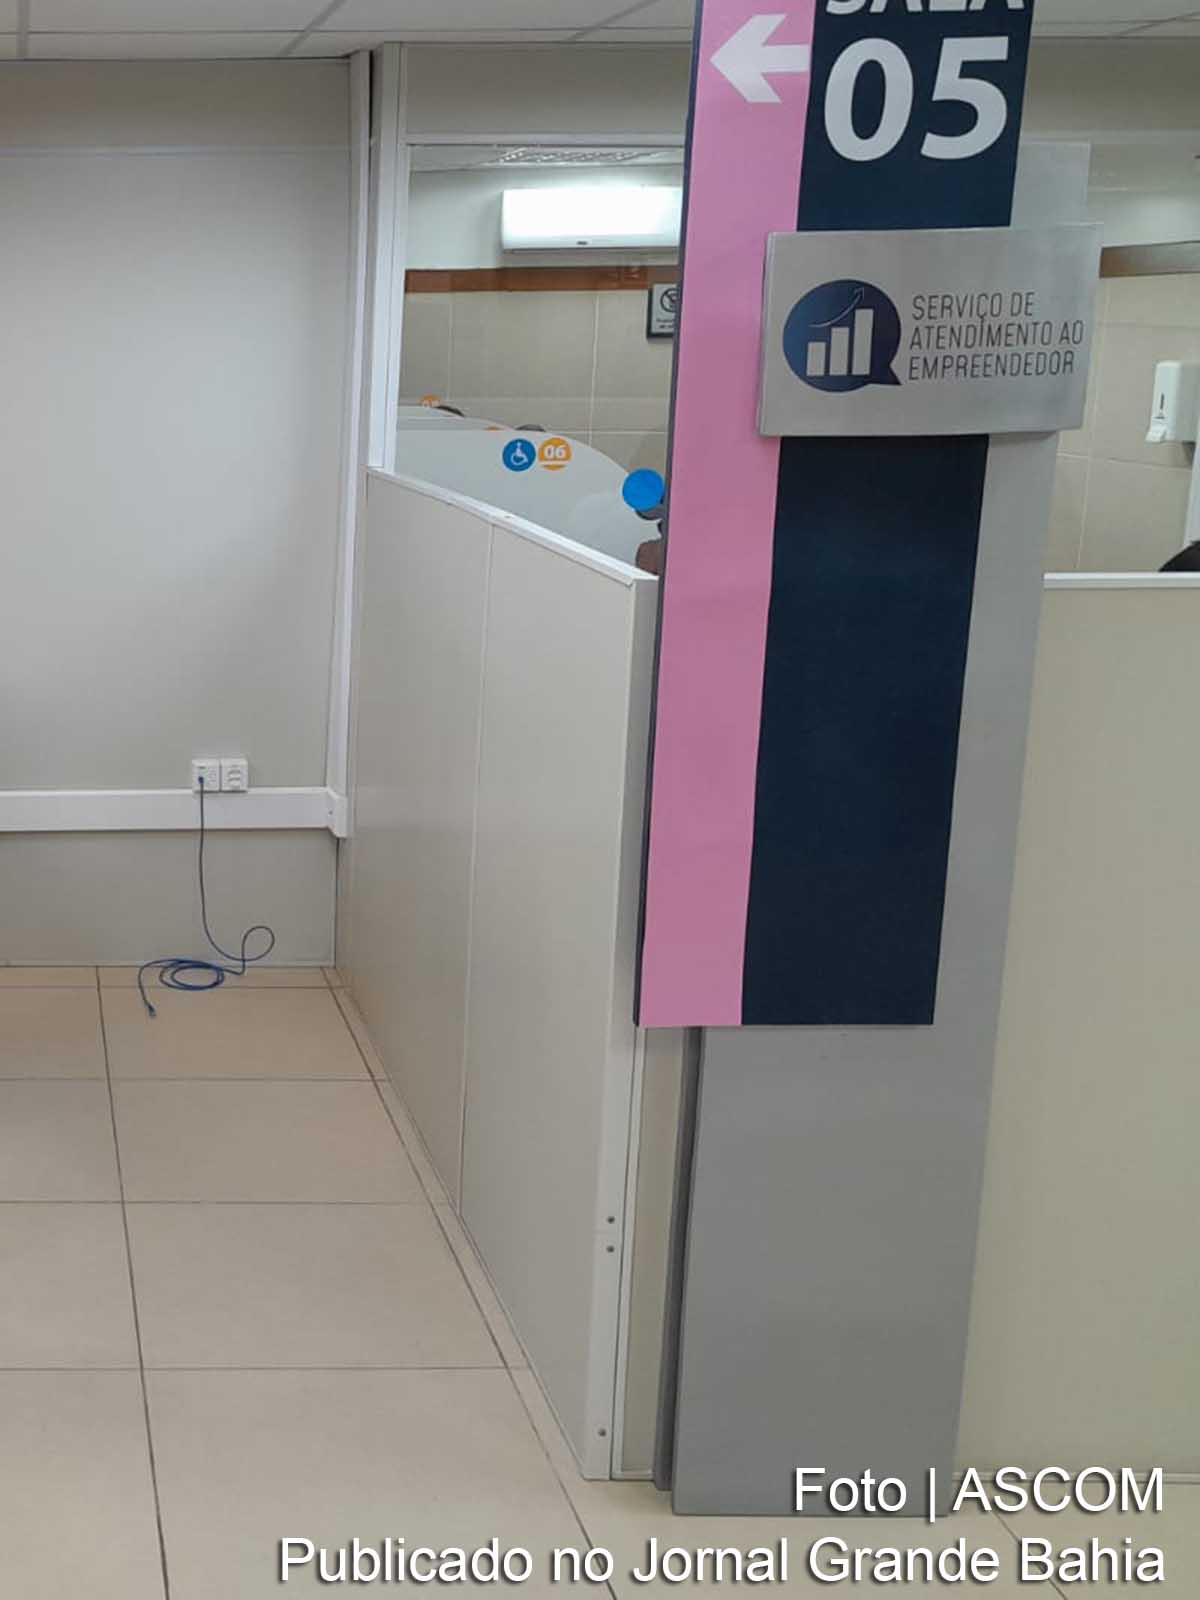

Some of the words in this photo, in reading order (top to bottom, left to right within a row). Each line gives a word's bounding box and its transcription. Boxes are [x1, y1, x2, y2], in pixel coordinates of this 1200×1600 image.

[824, 36, 1009, 161] 05
[912, 293, 1002, 320] SERVIÇO
[1010, 292, 1035, 317] DE
[910, 321, 1053, 350] ATENDIMENTO
[1059, 320, 1084, 345] AO
[908, 350, 1075, 380] EMPREENDEDOR
[544, 445, 567, 458] 06
